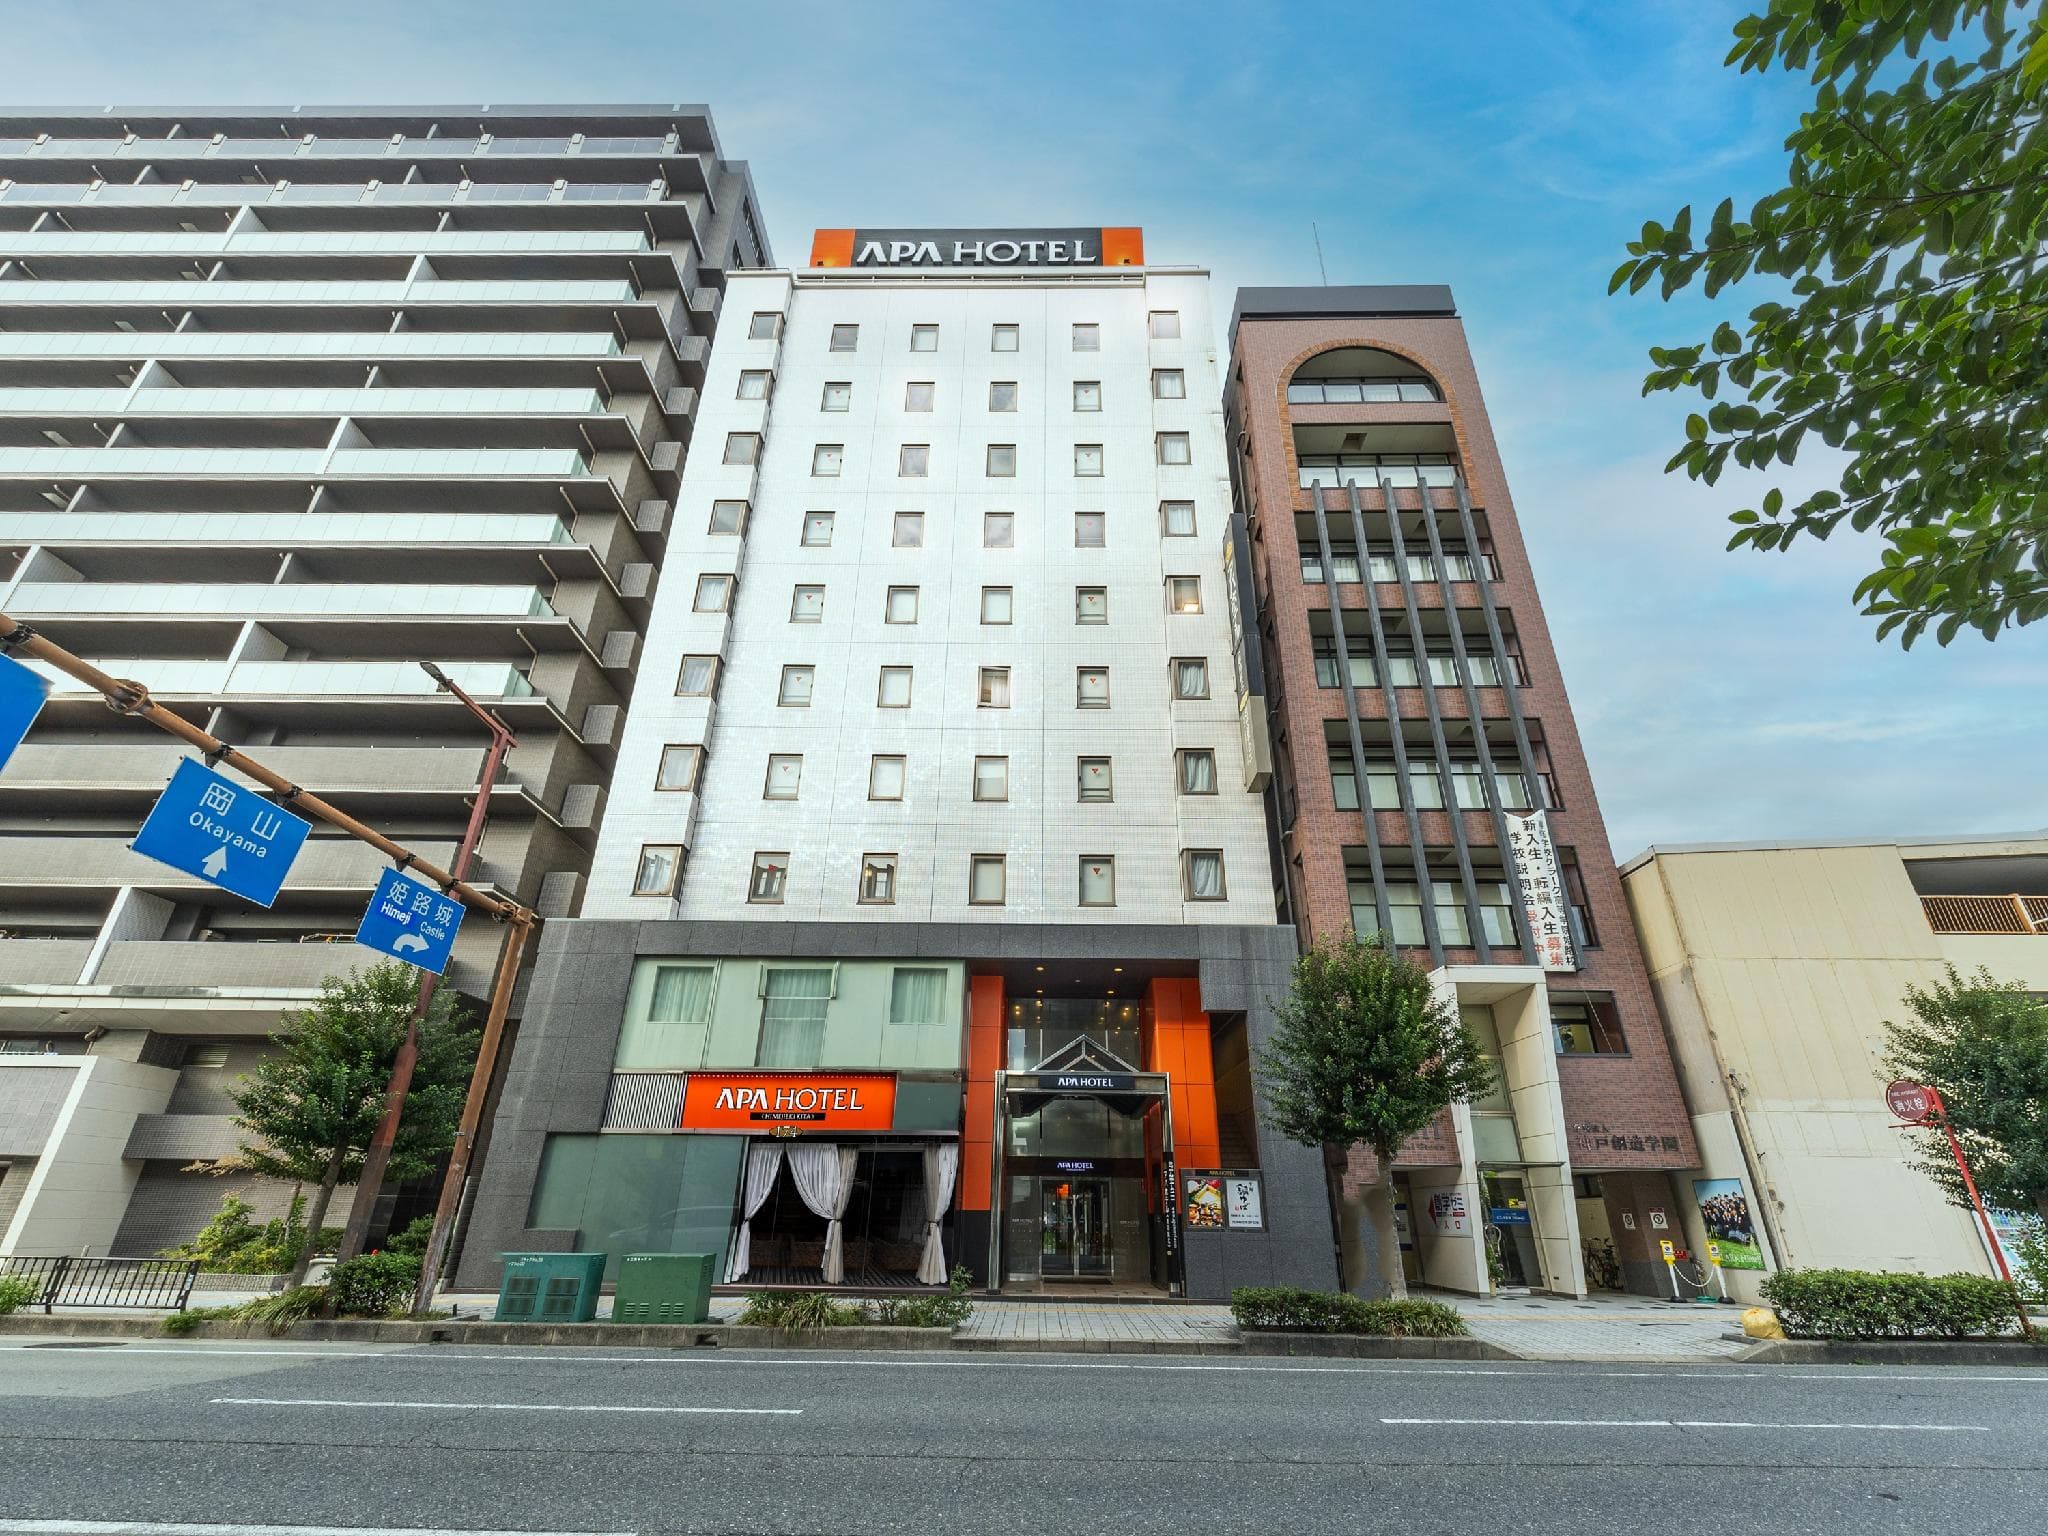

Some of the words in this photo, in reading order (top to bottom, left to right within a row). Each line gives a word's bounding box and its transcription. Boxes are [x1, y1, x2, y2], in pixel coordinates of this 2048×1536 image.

[856, 241, 943, 265] APA
[952, 240, 1097, 265] HOTEL
[200, 782, 282, 842] 岡山
[189, 812, 268, 859] Okayama
[387, 879, 452, 928] 姫路城
[1510, 831, 1545, 954] 学校説明会受付中
[1521, 819, 1564, 967] 新入生・転編入生募集
[380, 901, 412, 926] Himeji
[420, 920, 446, 942] Castle
[714, 1087, 769, 1111] APA
[774, 1087, 864, 1111] HOTEL
[1057, 1077, 1079, 1088] APA
[1080, 1077, 1114, 1088] HOTEL
[1893, 1097, 1925, 1112] 消火栓
[775, 1125, 798, 1138] 174
